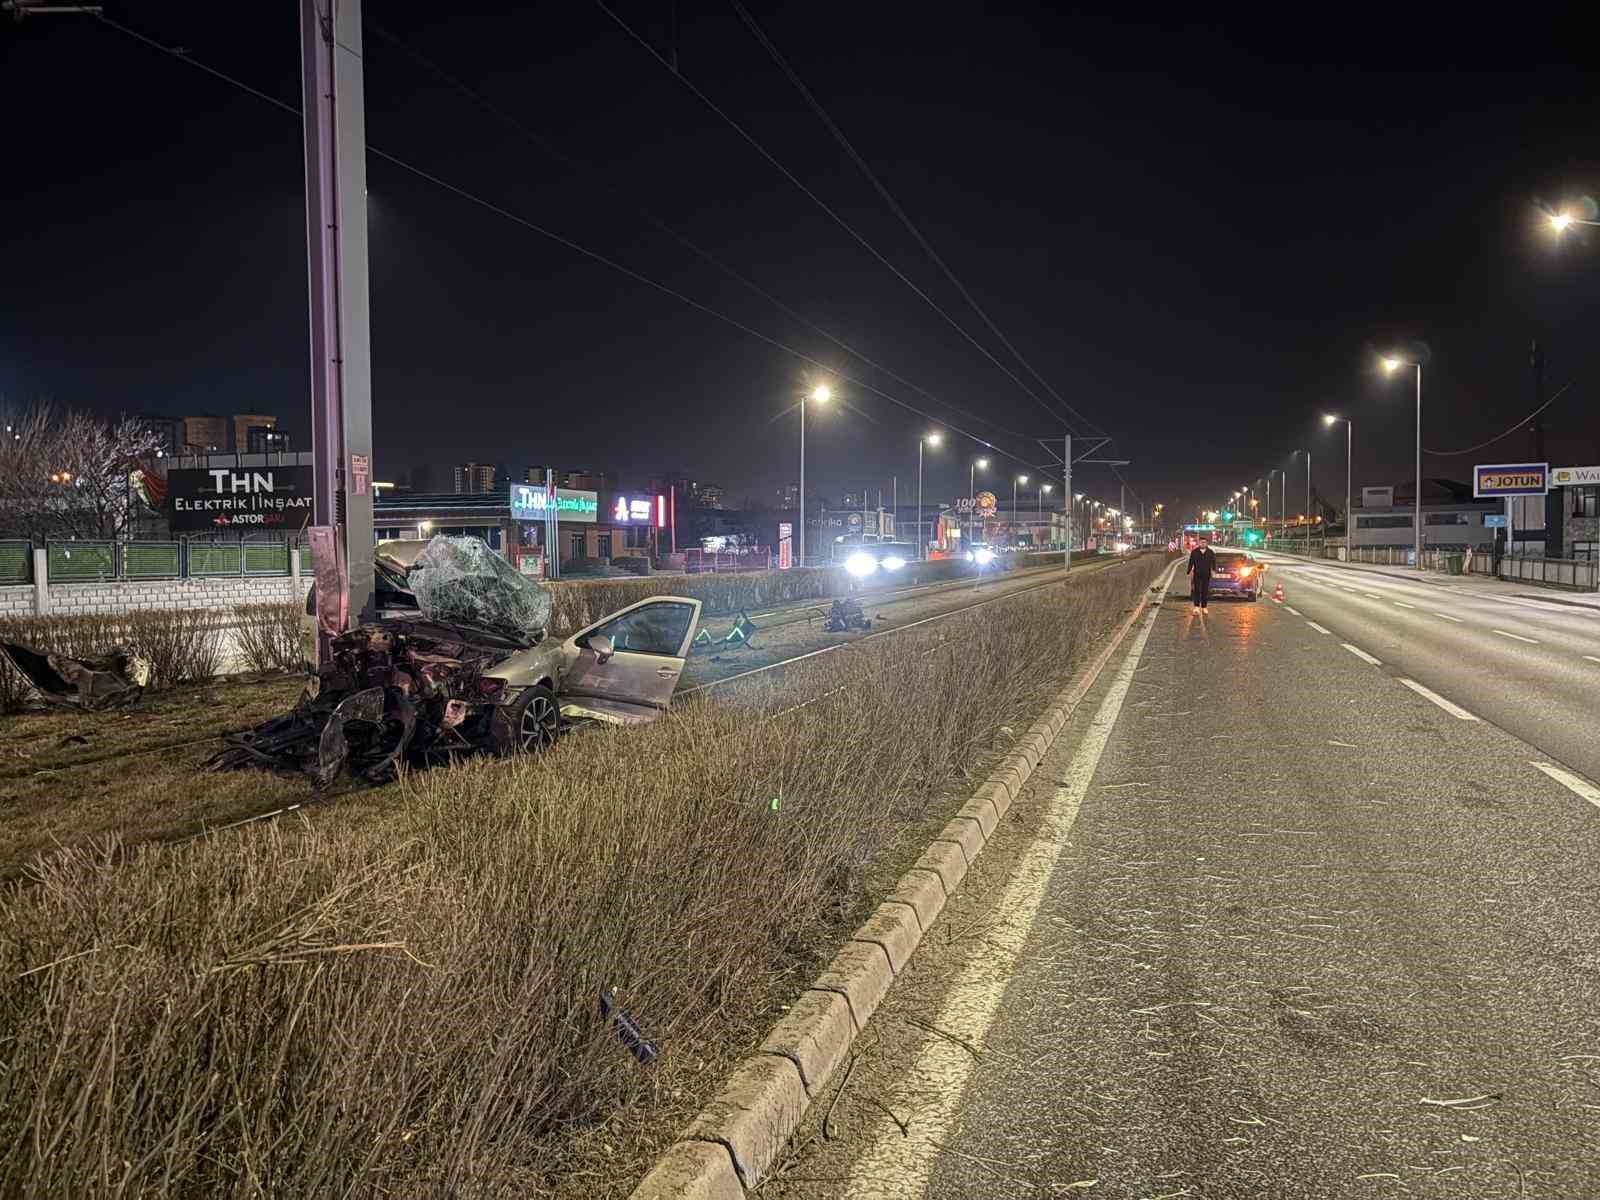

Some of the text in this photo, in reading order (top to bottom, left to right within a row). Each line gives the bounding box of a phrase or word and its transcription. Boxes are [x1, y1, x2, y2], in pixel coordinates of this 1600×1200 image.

[209, 469, 274, 494] THN
[1496, 475, 1540, 487] JOTUN
[175, 496, 248, 511] ELEKTRİK
[231, 514, 264, 524] ASTOR
